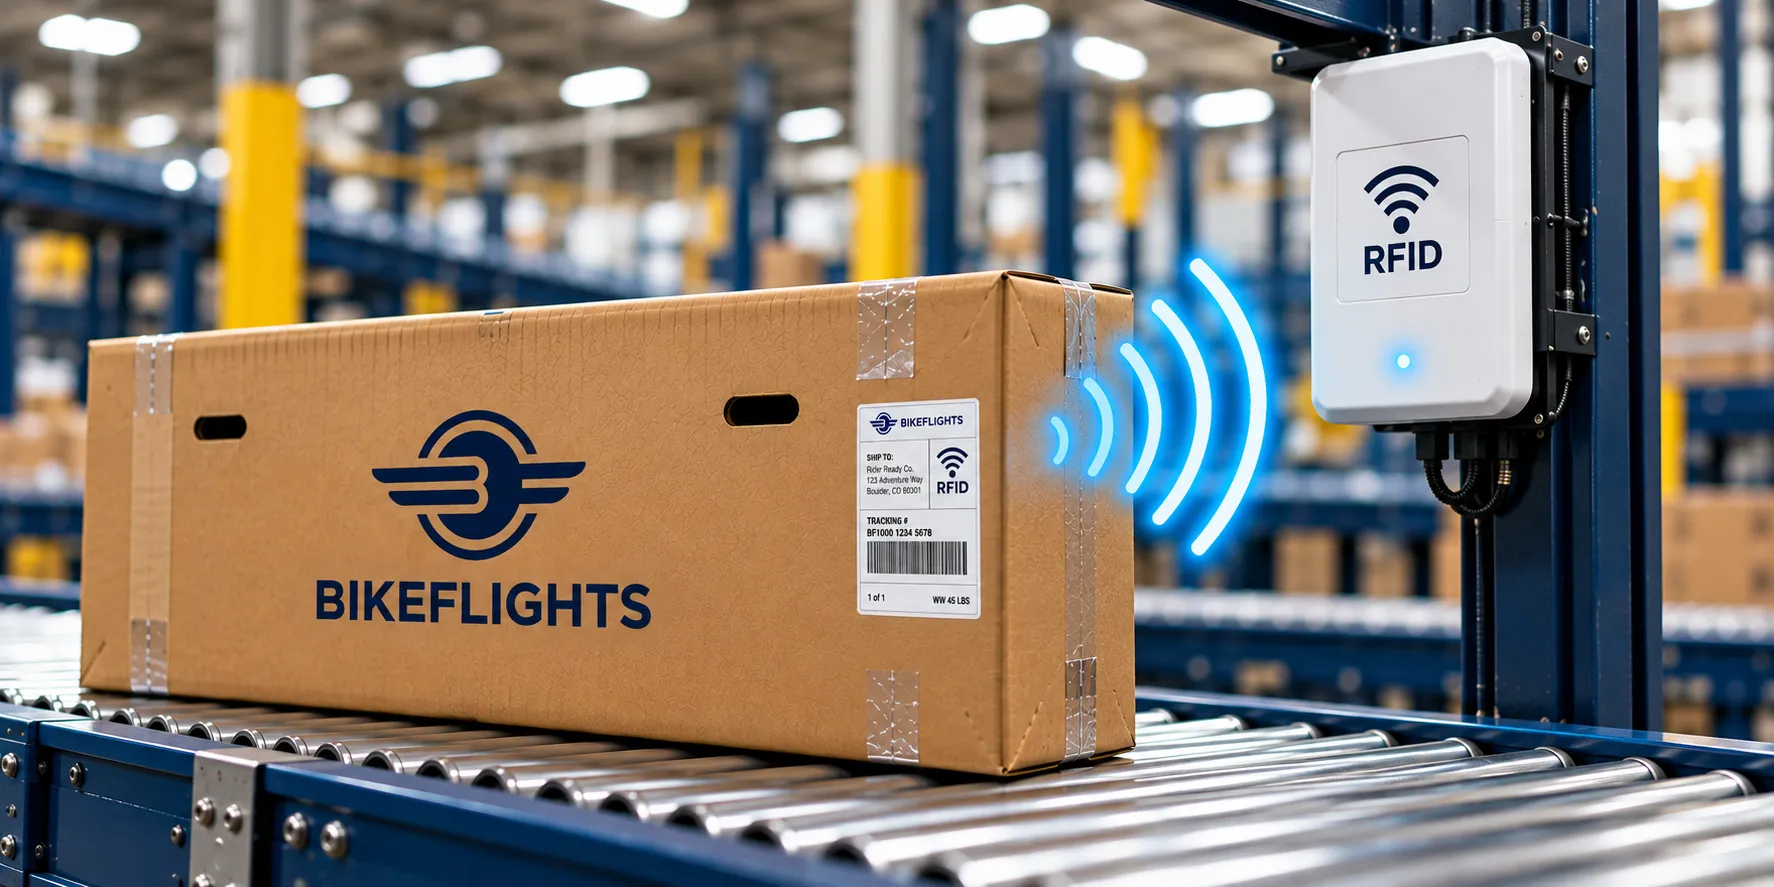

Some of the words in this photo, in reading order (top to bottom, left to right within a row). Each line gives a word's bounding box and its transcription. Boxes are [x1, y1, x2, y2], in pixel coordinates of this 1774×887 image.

[1364, 239, 1443, 275] RFID
[900, 415, 964, 428] BIKEFLIGHTS
[866, 453, 882, 461] SHIP
[883, 453, 894, 461] TO:
[883, 465, 902, 474] Ready
[903, 464, 914, 473] Co.
[866, 476, 878, 484] 123
[910, 475, 923, 484] Way
[936, 480, 969, 494] RFID
[867, 516, 902, 525] TRACKING
[867, 528, 894, 537] BF1000
[895, 528, 913, 537] 1234
[914, 528, 932, 537] 5678
[867, 593, 871, 601] 1
[873, 593, 880, 601] of
[932, 595, 946, 604] WW
[947, 596, 956, 604] 45
[957, 596, 971, 605] LBS
[315, 579, 652, 630] BIKEFLIGHTS
